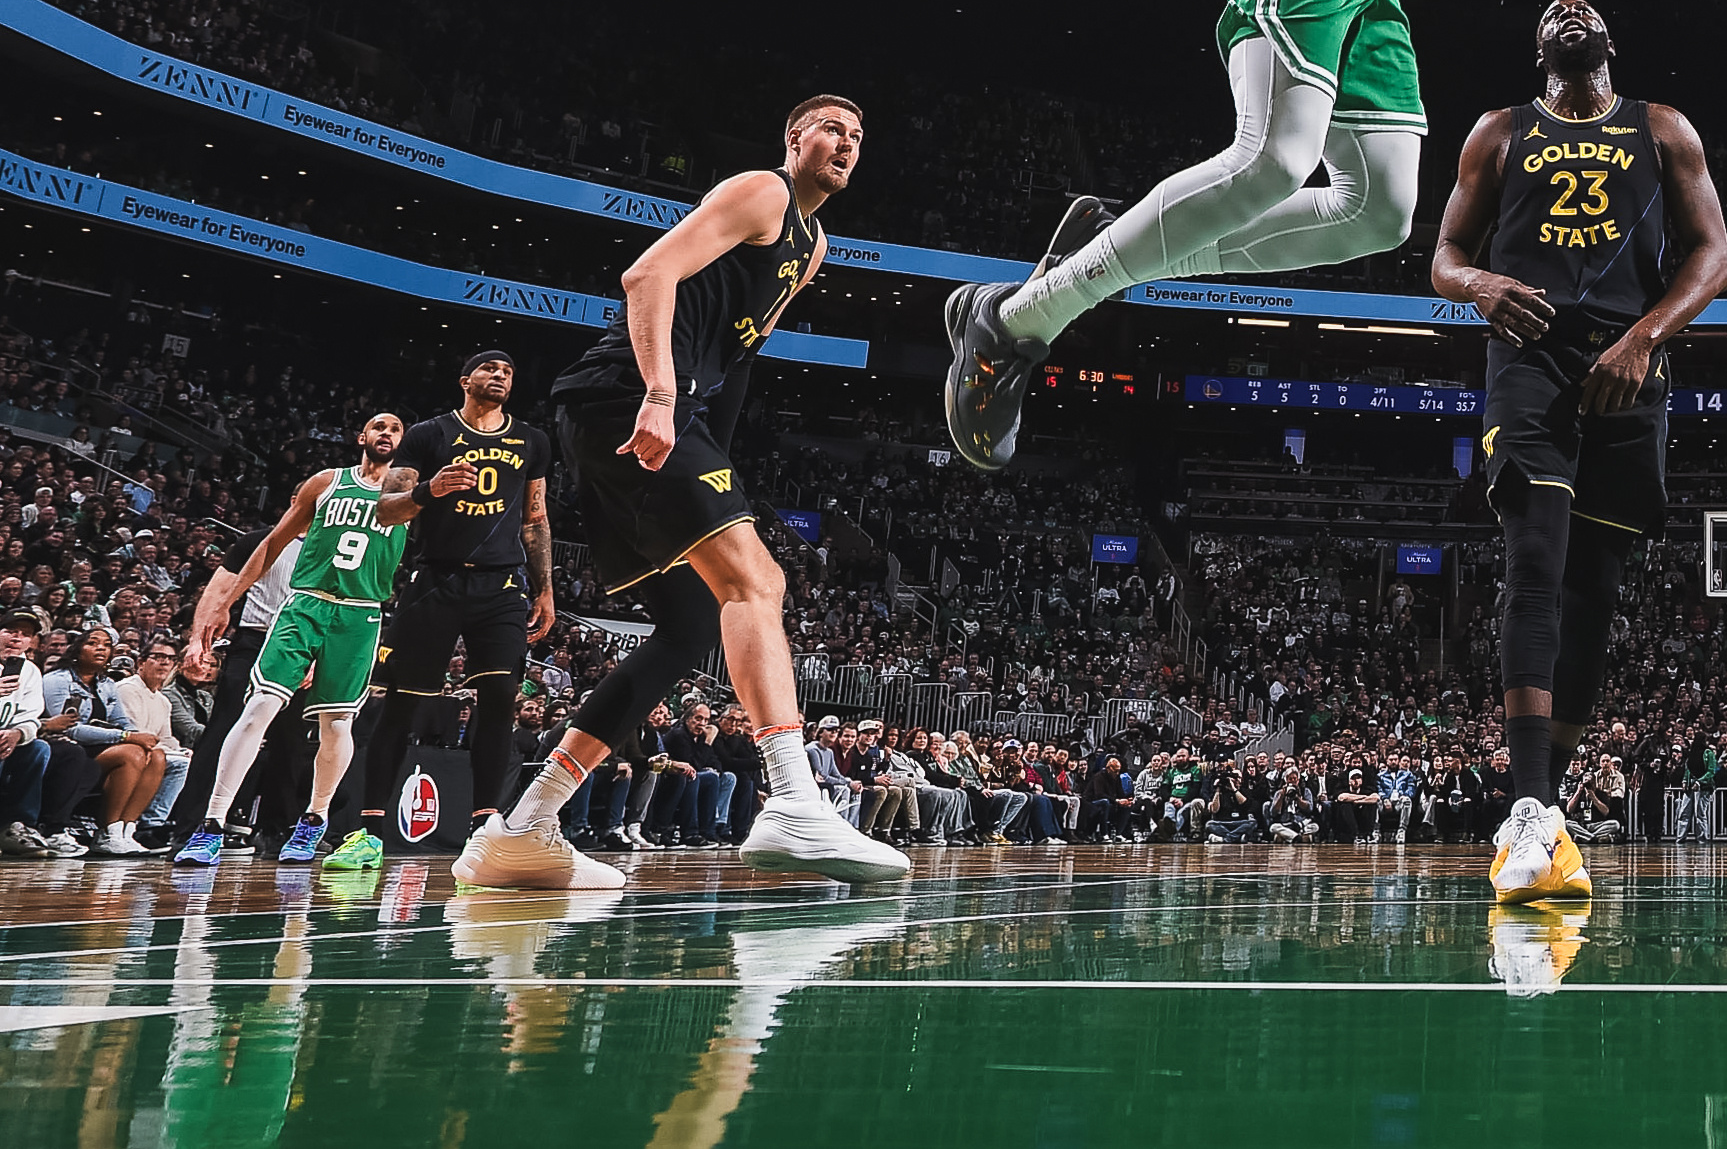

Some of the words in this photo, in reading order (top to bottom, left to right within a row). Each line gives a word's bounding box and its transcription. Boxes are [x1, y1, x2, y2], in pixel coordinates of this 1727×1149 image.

[138, 56, 251, 110] ZENNI
[283, 104, 351, 139] Eyewear
[353, 127, 376, 148] for
[377, 135, 446, 168] Everyone
[1523, 142, 1635, 173] GOLDEN
[1550, 170, 1609, 215] 23
[0, 158, 84, 204] ENNI
[121, 196, 199, 229] Eyewear
[201, 216, 227, 237] for
[228, 224, 306, 257] Everyone
[602, 192, 692, 228] ZENN
[1539, 219, 1621, 248] STATE
[462, 280, 571, 317] ZENNI
[1145, 286, 1204, 303] Eyewear
[1206, 290, 1227, 303] for
[1228, 291, 1293, 308] Everyone
[1431, 303, 1485, 320] ZEN
[1079, 370, 1103, 383] 6:30
[1167, 381, 1179, 393] 15
[1370, 397, 1395, 409] 4/11
[1419, 399, 1444, 411] 5/14
[1456, 401, 1476, 413] 35.7
[1695, 393, 1723, 411] 14
[452, 448, 524, 470] GOLDEN
[477, 466, 498, 495] 0
[455, 499, 505, 516] STATE
[332, 530, 370, 570] 9
[1102, 544, 1127, 552] ULTRA
